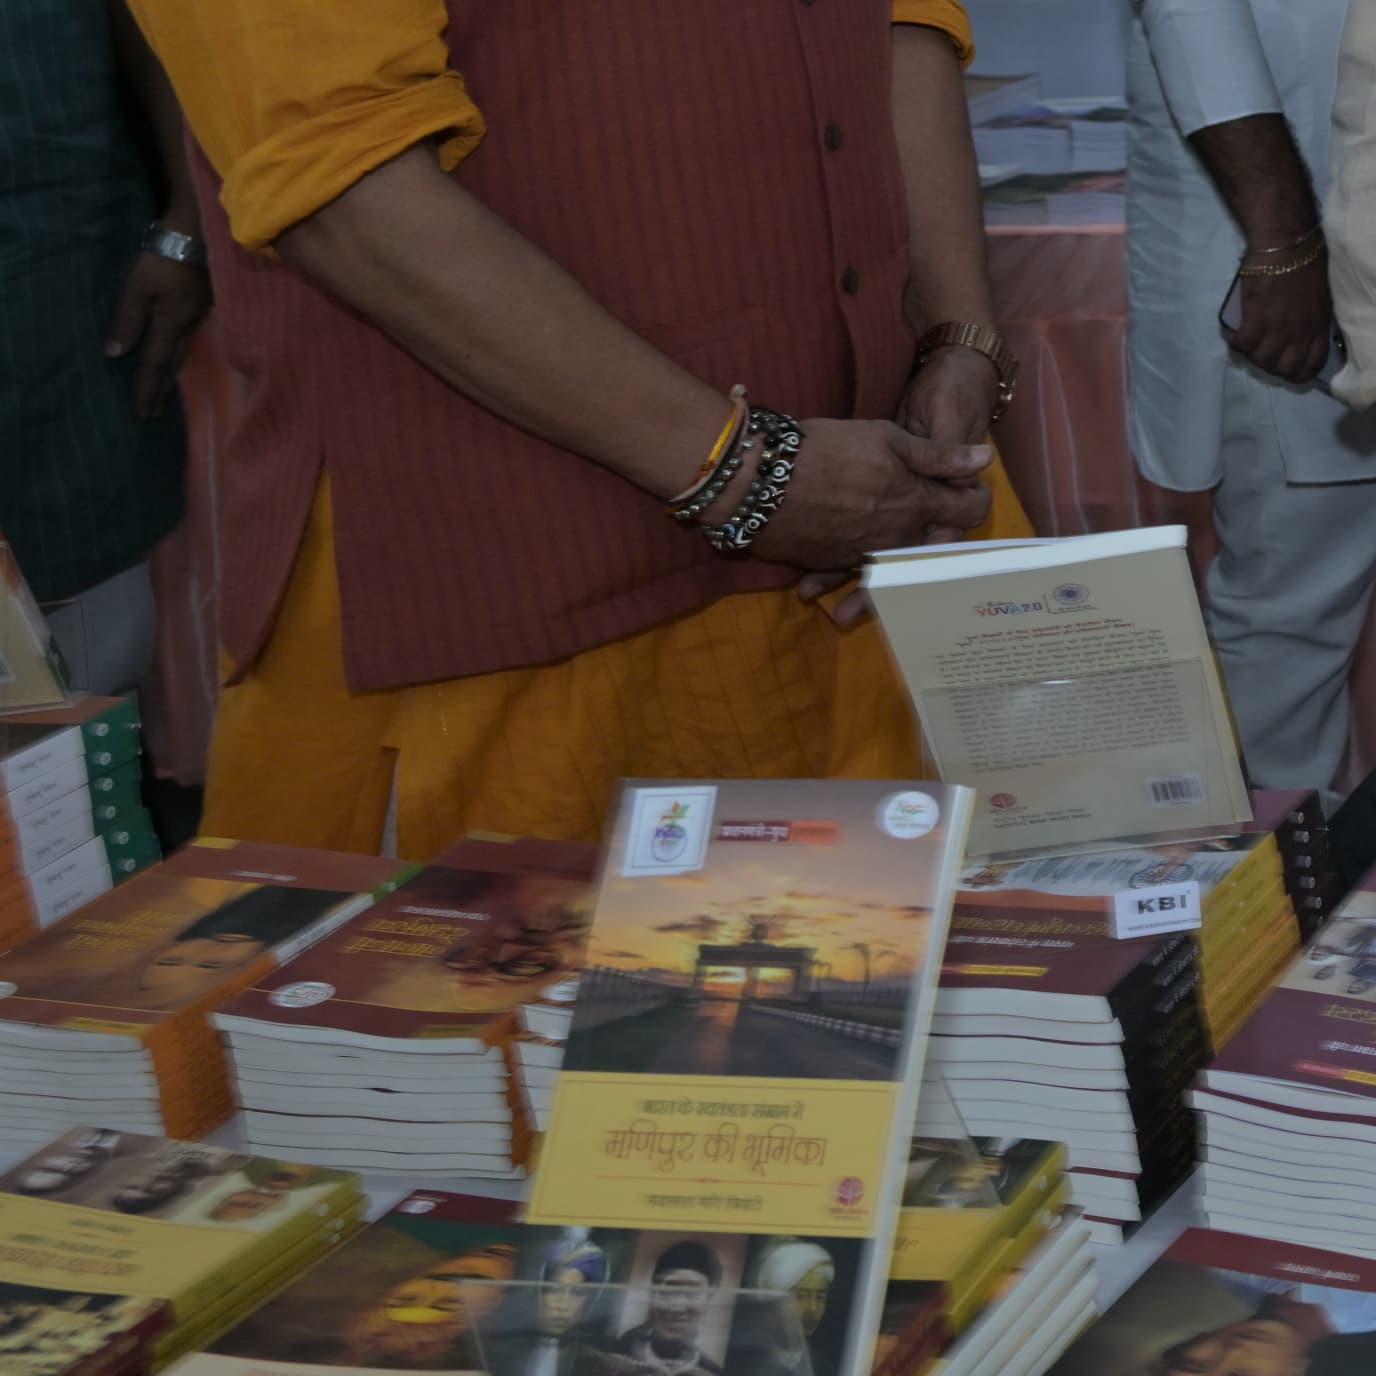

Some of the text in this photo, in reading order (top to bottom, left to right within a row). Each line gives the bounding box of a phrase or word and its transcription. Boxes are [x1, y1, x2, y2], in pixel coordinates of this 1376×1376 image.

[1137, 894, 1187, 914] KBI
[605, 1118, 831, 1177] मणिपुर की भूमिका
